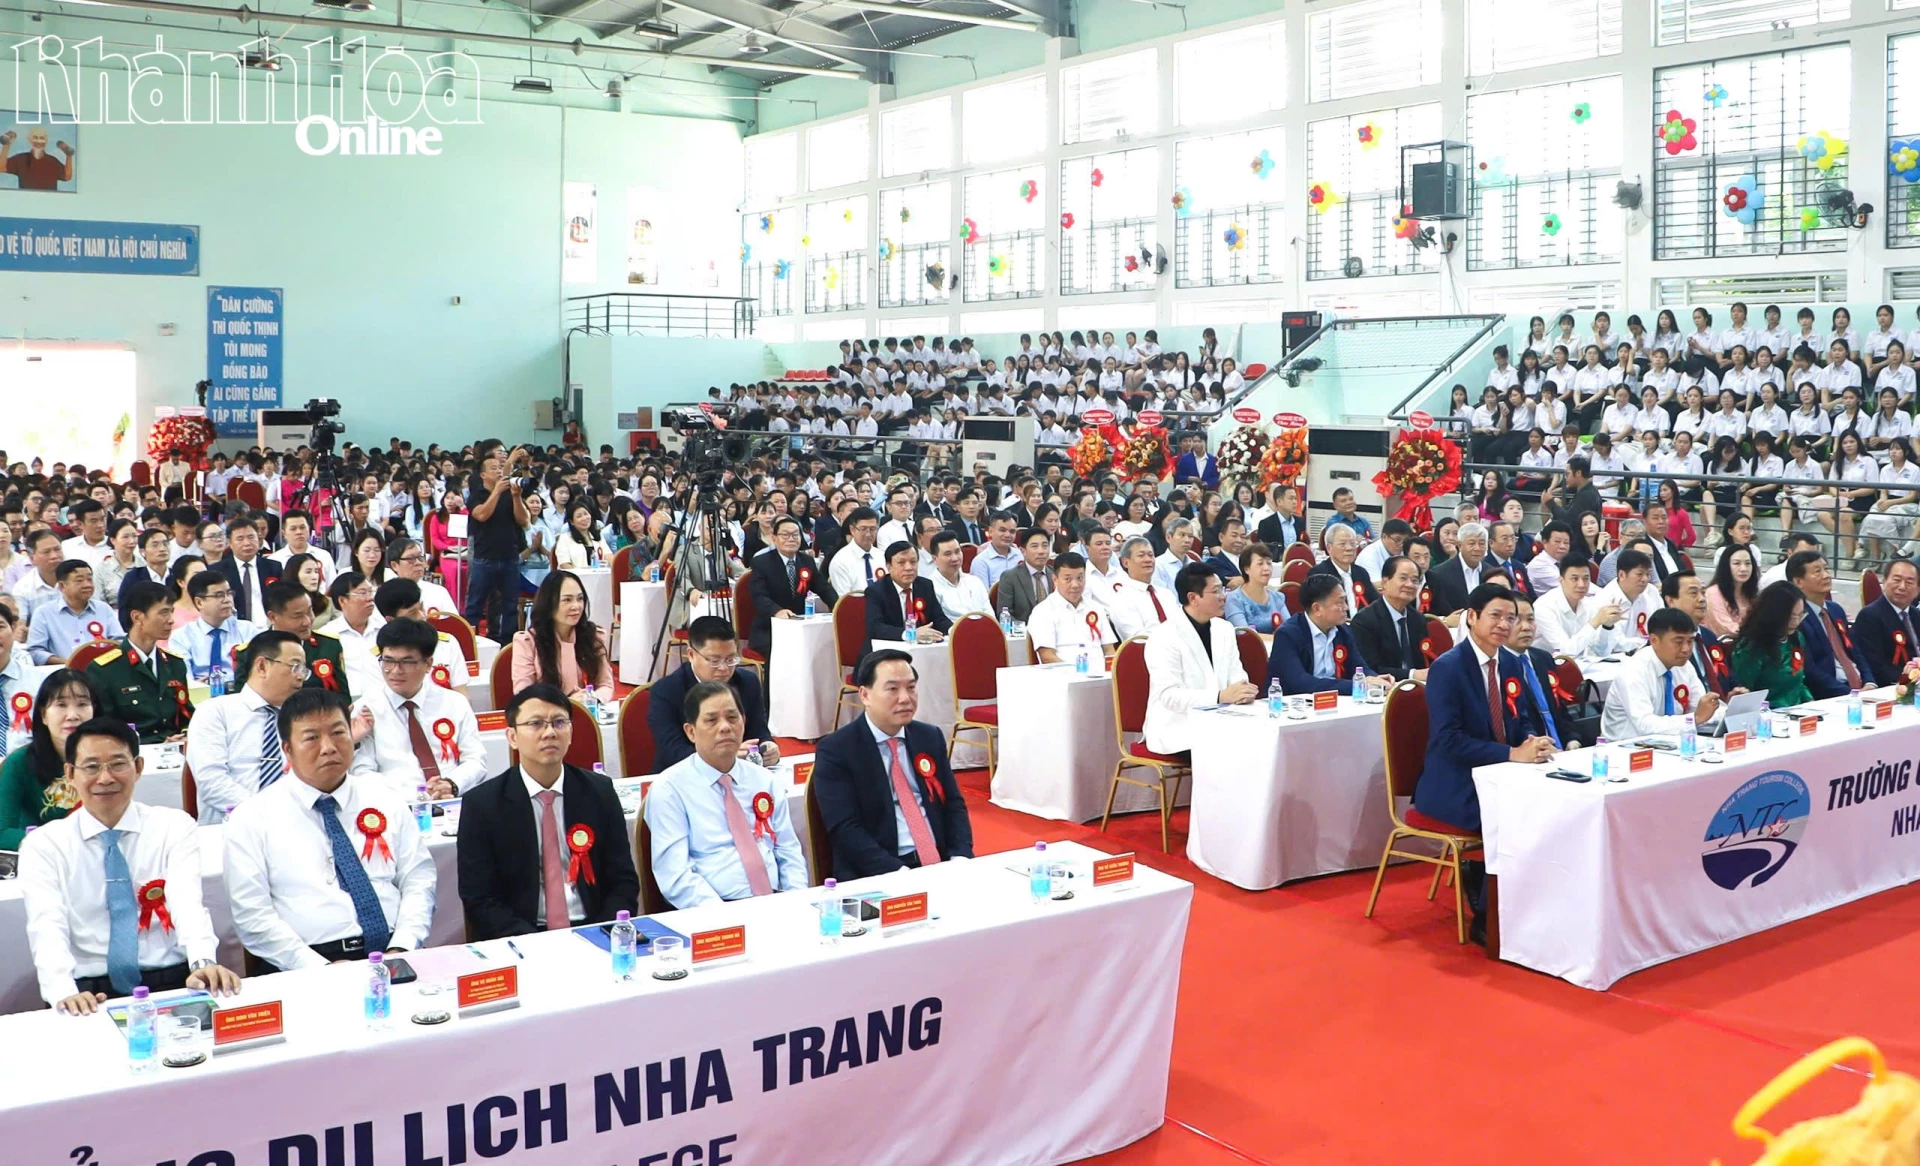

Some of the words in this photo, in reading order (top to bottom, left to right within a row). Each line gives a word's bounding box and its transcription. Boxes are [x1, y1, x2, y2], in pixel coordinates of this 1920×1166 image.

[7, 231, 19, 259] VỆ
[21, 228, 34, 256] TỔ
[35, 230, 60, 257] QUỐC
[62, 234, 82, 261] VIỆT
[84, 238, 105, 258] NAM
[108, 236, 121, 259] XÃ
[123, 236, 138, 263] HỘI
[140, 234, 157, 260] CHỦ
[160, 237, 187, 260] NGHĨA
[243, 296, 274, 314] CƯỜNG
[212, 318, 226, 335] THÌ
[228, 316, 252, 337] QUỐC
[253, 321, 279, 339] THỊNH
[224, 340, 238, 357] TÔI
[240, 343, 268, 358] MONG
[222, 361, 247, 379] ĐỒNG
[250, 363, 268, 379] BÀO
[214, 387, 223, 401] AI
[225, 385, 250, 401] CŨNG
[212, 406, 230, 426] TẬP
[231, 403, 248, 423] THỂ
[1721, 797, 1736, 814] NHA
[1736, 780, 1759, 799] TRANG
[1759, 774, 1785, 785] TOURISM
[1827, 760, 1911, 811] TRƯỜNG
[594, 1048, 733, 1134] NHA
[753, 996, 942, 1093] TRANG
